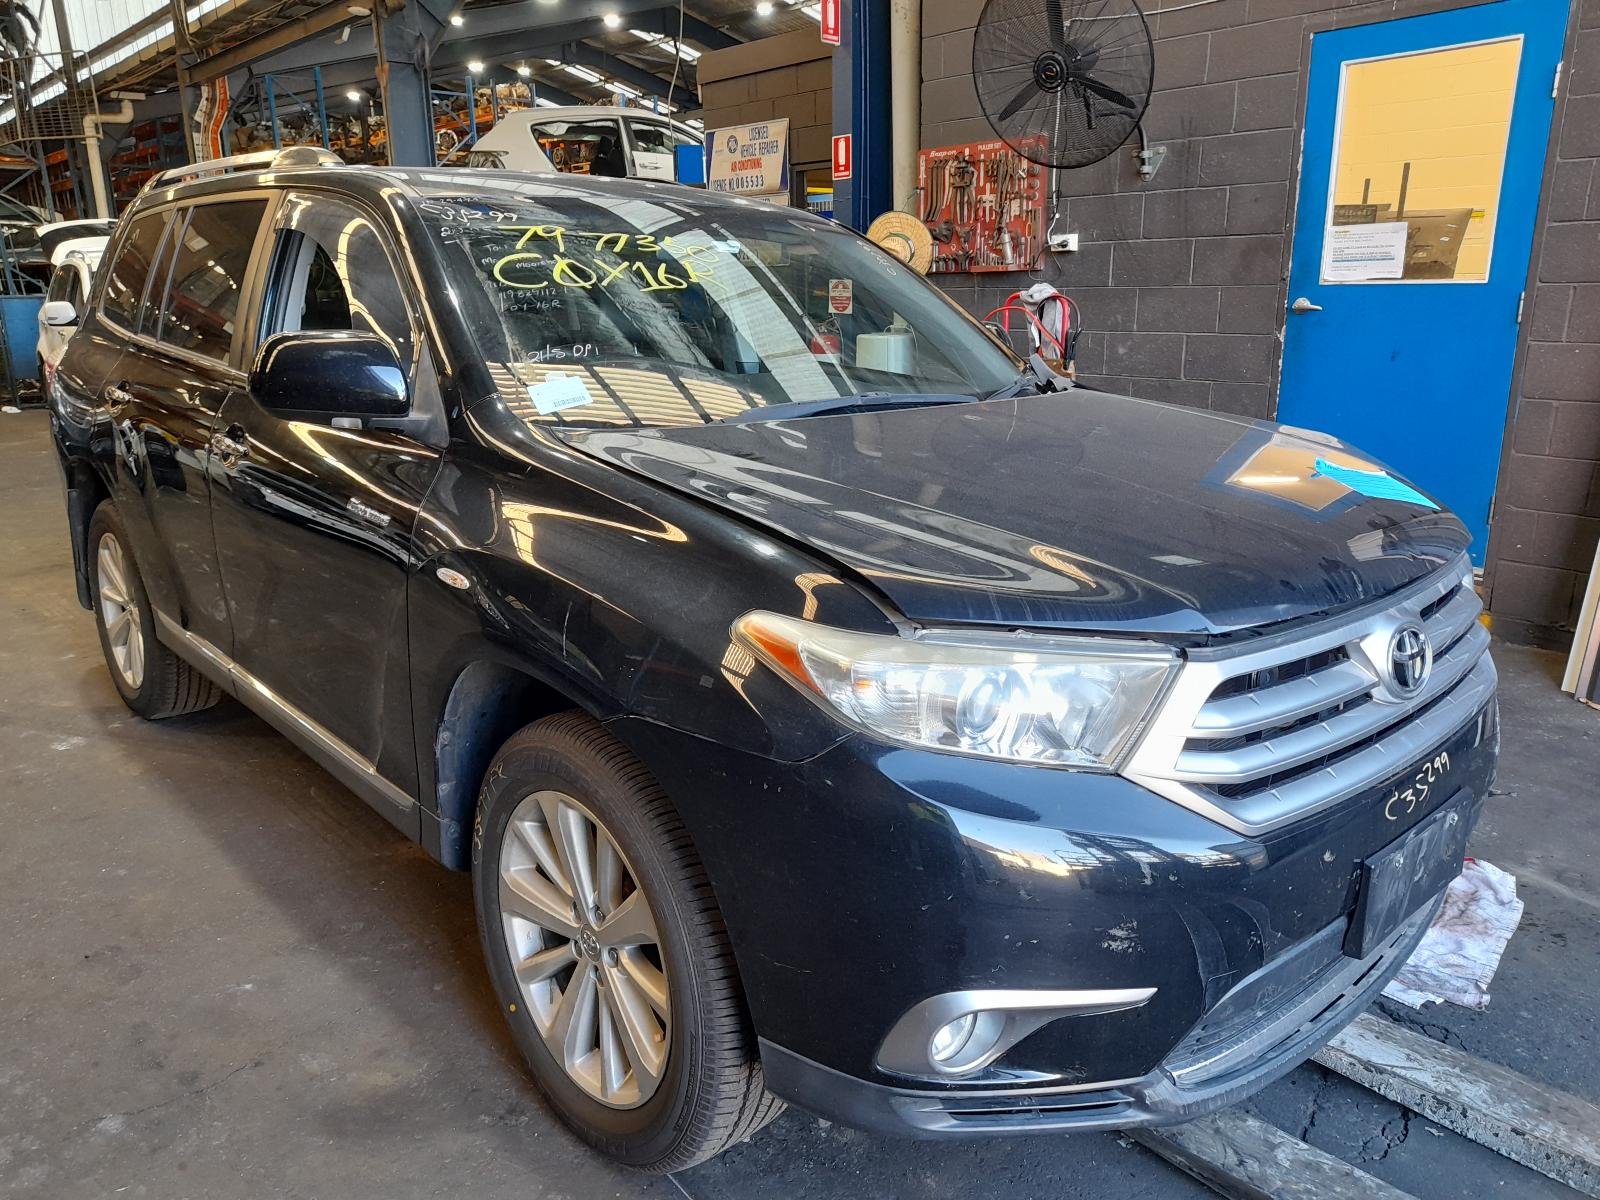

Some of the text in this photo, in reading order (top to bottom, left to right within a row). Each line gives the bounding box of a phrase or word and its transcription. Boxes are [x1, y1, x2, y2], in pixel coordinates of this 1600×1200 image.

[748, 125, 769, 142] LICENSED
[740, 140, 779, 158] VEHICLE REPAIRER
[1384, 751, 1450, 820] C35299
